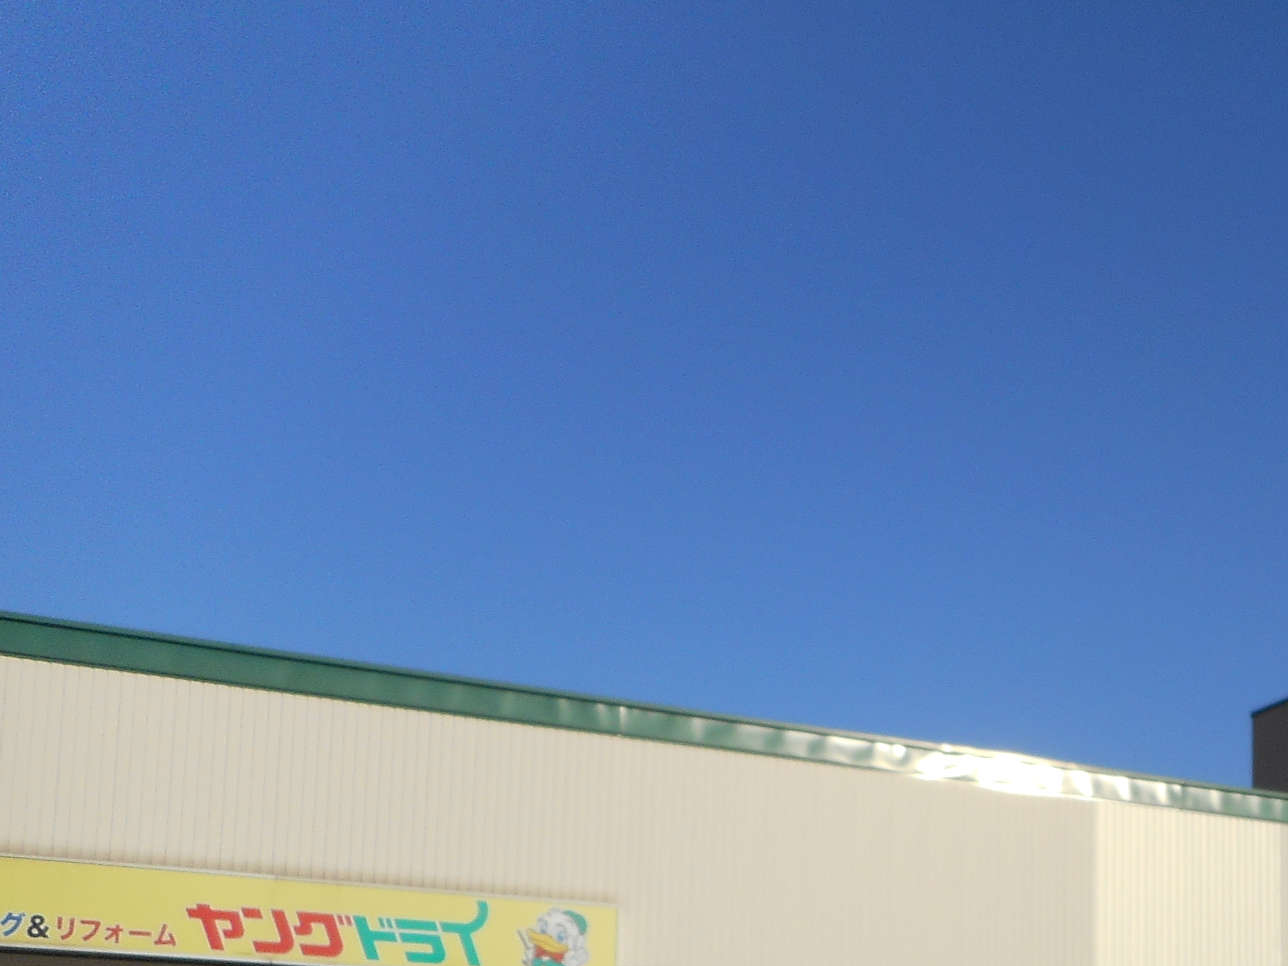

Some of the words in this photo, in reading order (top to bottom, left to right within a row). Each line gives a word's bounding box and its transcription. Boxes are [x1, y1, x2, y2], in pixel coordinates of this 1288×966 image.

[186, 901, 488, 966] ヤングドライ
